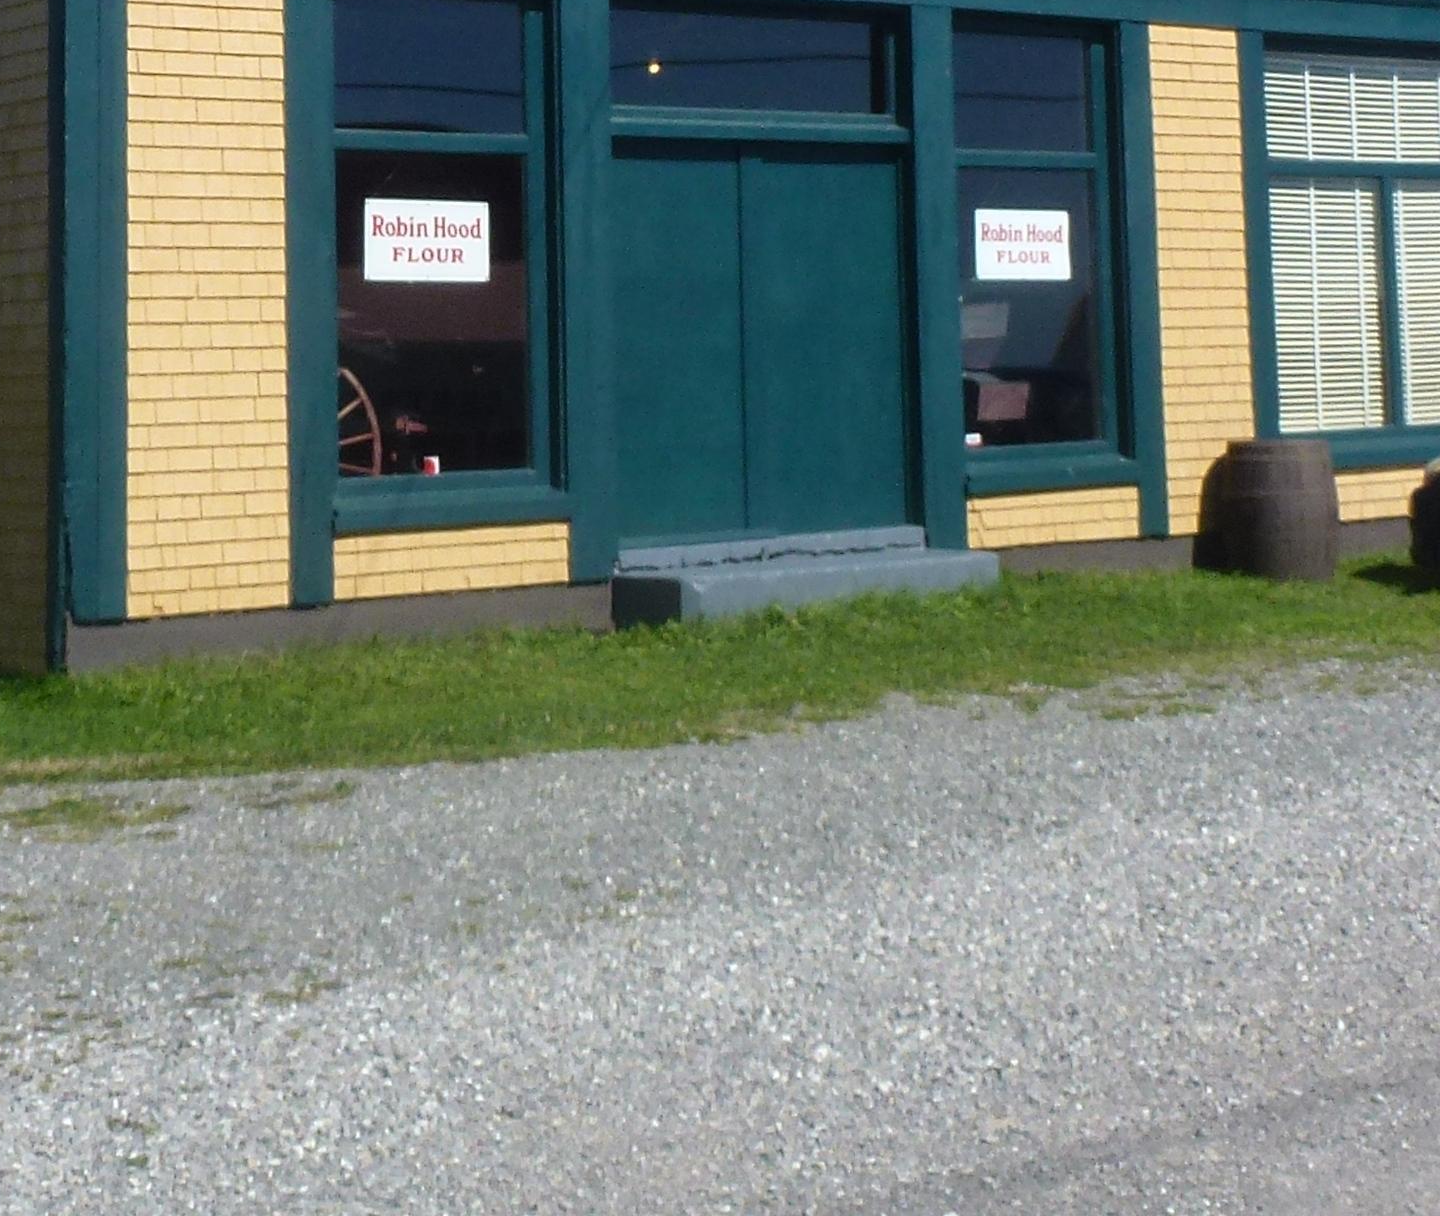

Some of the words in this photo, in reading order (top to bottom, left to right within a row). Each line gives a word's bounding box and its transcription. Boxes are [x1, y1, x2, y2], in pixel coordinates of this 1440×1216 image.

[371, 214, 429, 238] Robin
[433, 216, 482, 239] Hood
[981, 222, 1023, 242] Robin
[1026, 223, 1064, 244] Hood
[392, 246, 465, 264] FLOUR
[997, 250, 1052, 264] FLOUR
